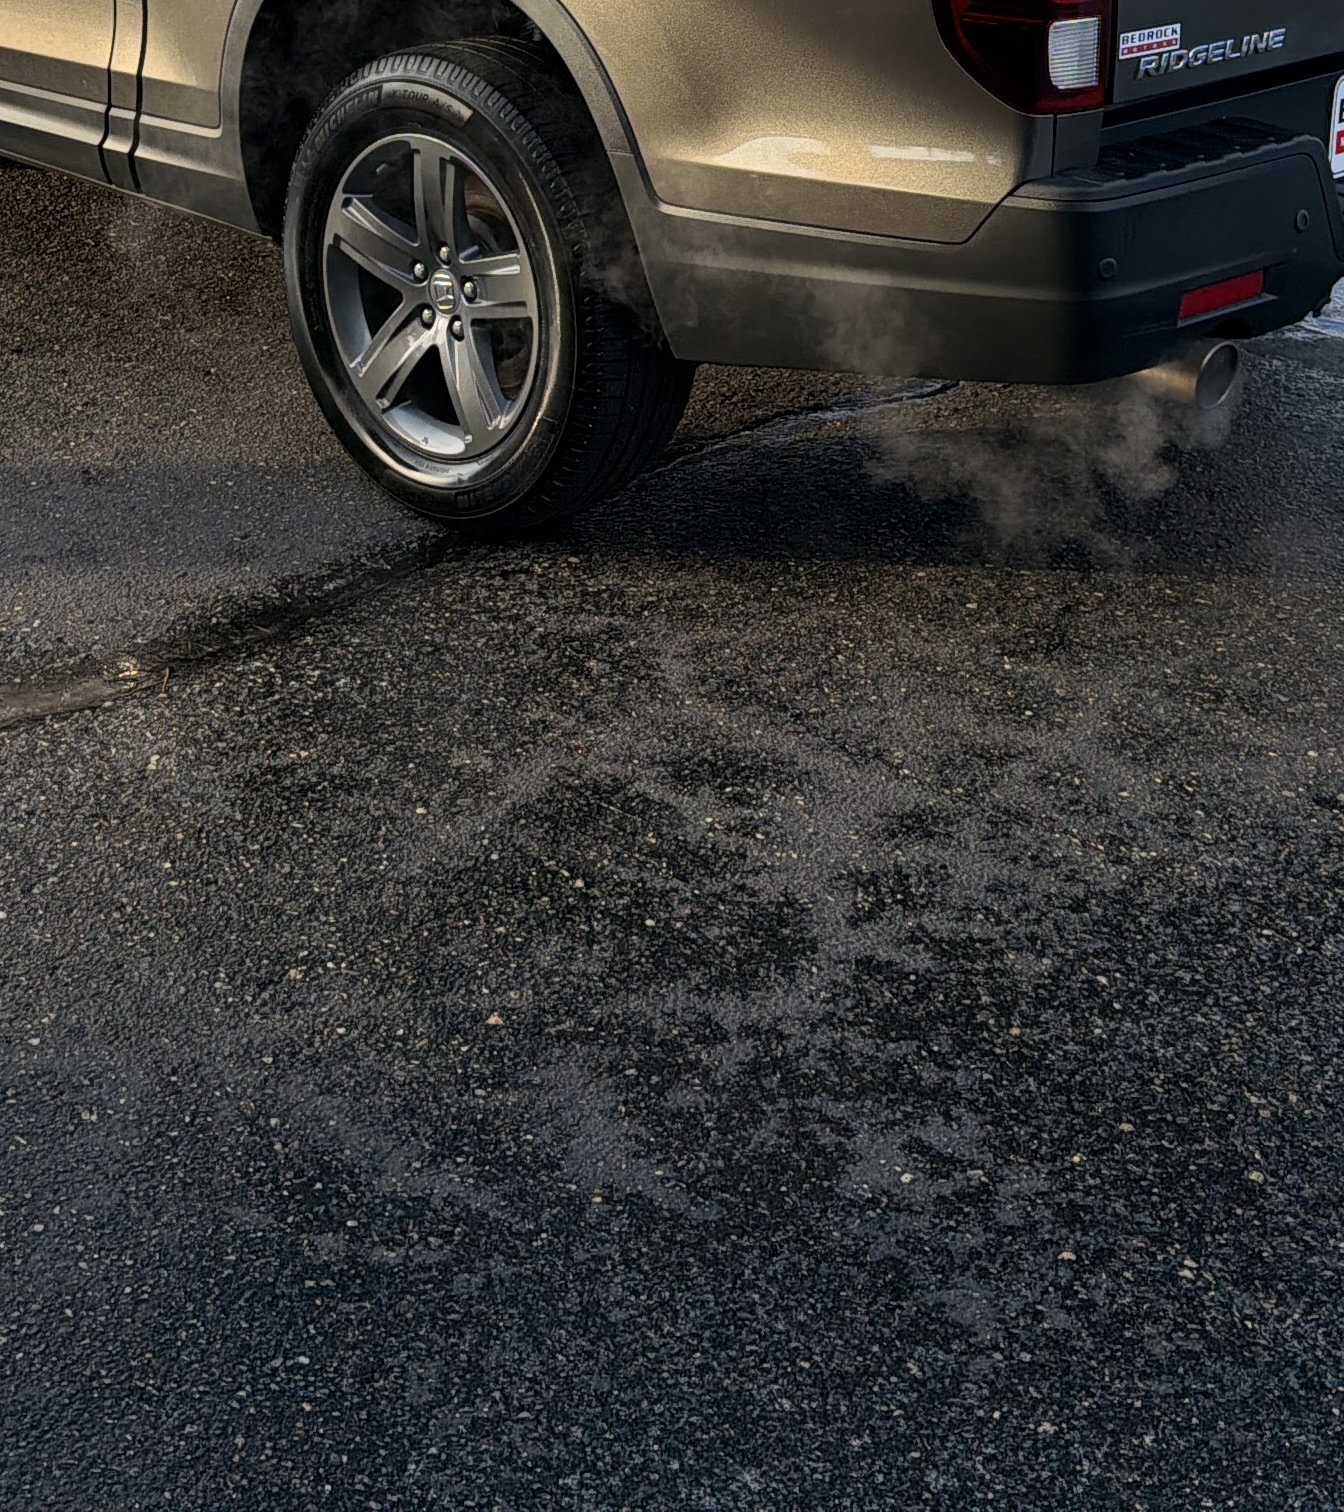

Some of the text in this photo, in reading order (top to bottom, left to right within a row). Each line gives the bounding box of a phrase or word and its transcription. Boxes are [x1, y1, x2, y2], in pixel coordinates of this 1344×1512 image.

[1121, 27, 1179, 46] BEDROCK
[1122, 39, 1178, 55] MOTORS
[1136, 27, 1287, 80] RIDGELINE
[402, 90, 430, 103] TOUR
